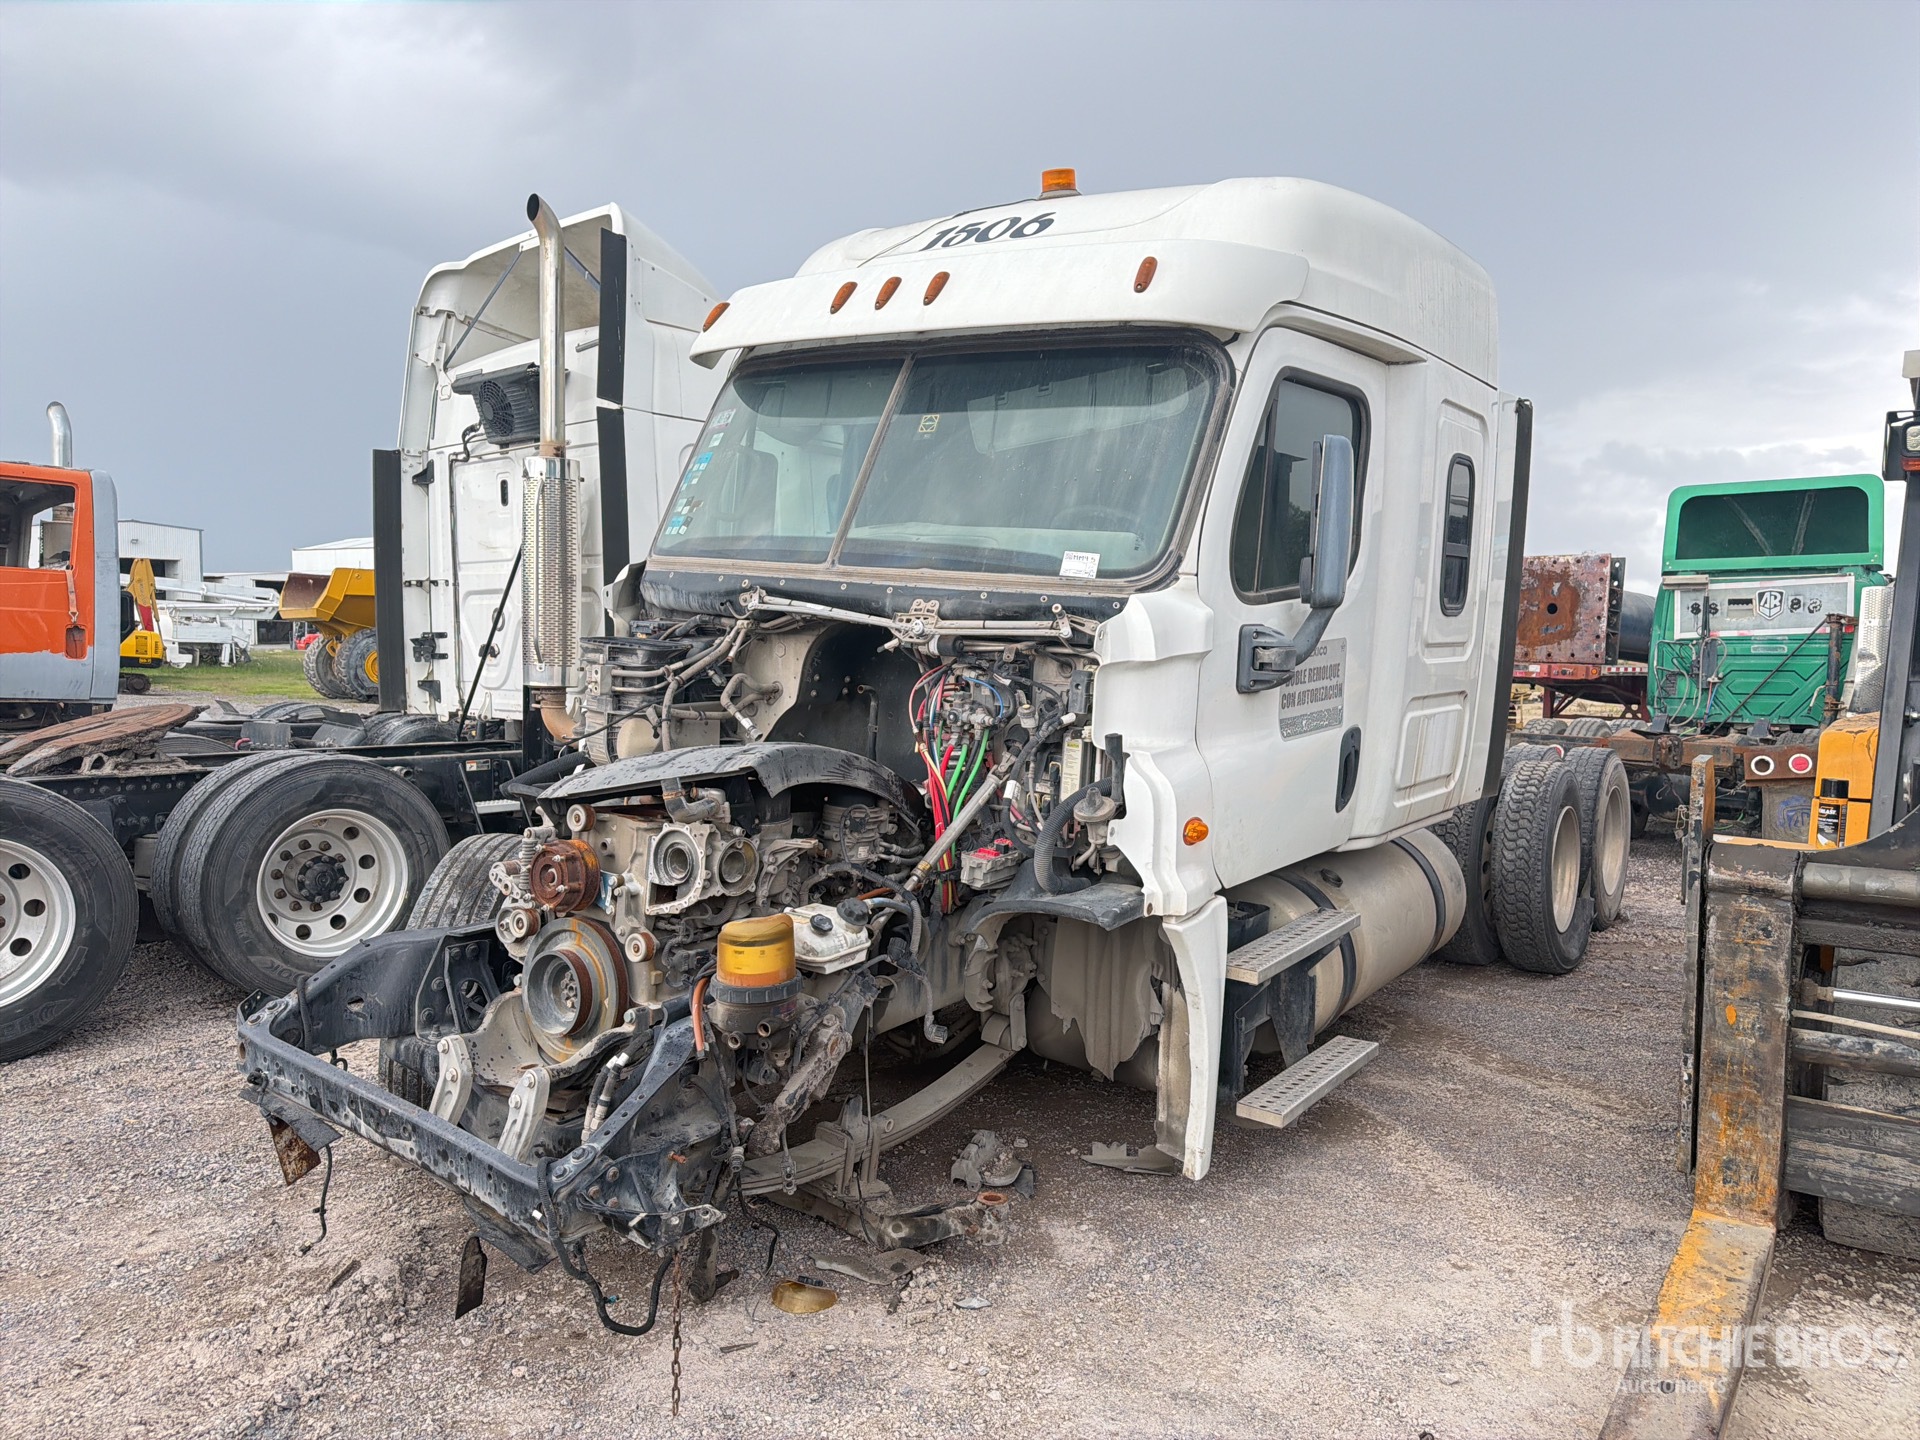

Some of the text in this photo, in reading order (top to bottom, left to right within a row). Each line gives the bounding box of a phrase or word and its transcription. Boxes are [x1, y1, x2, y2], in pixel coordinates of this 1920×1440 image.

[918, 212, 1056, 251] 1506
[1308, 663, 1341, 683] REMOLQUE
[1281, 680, 1343, 710] CON AUTORIZACIÓN
